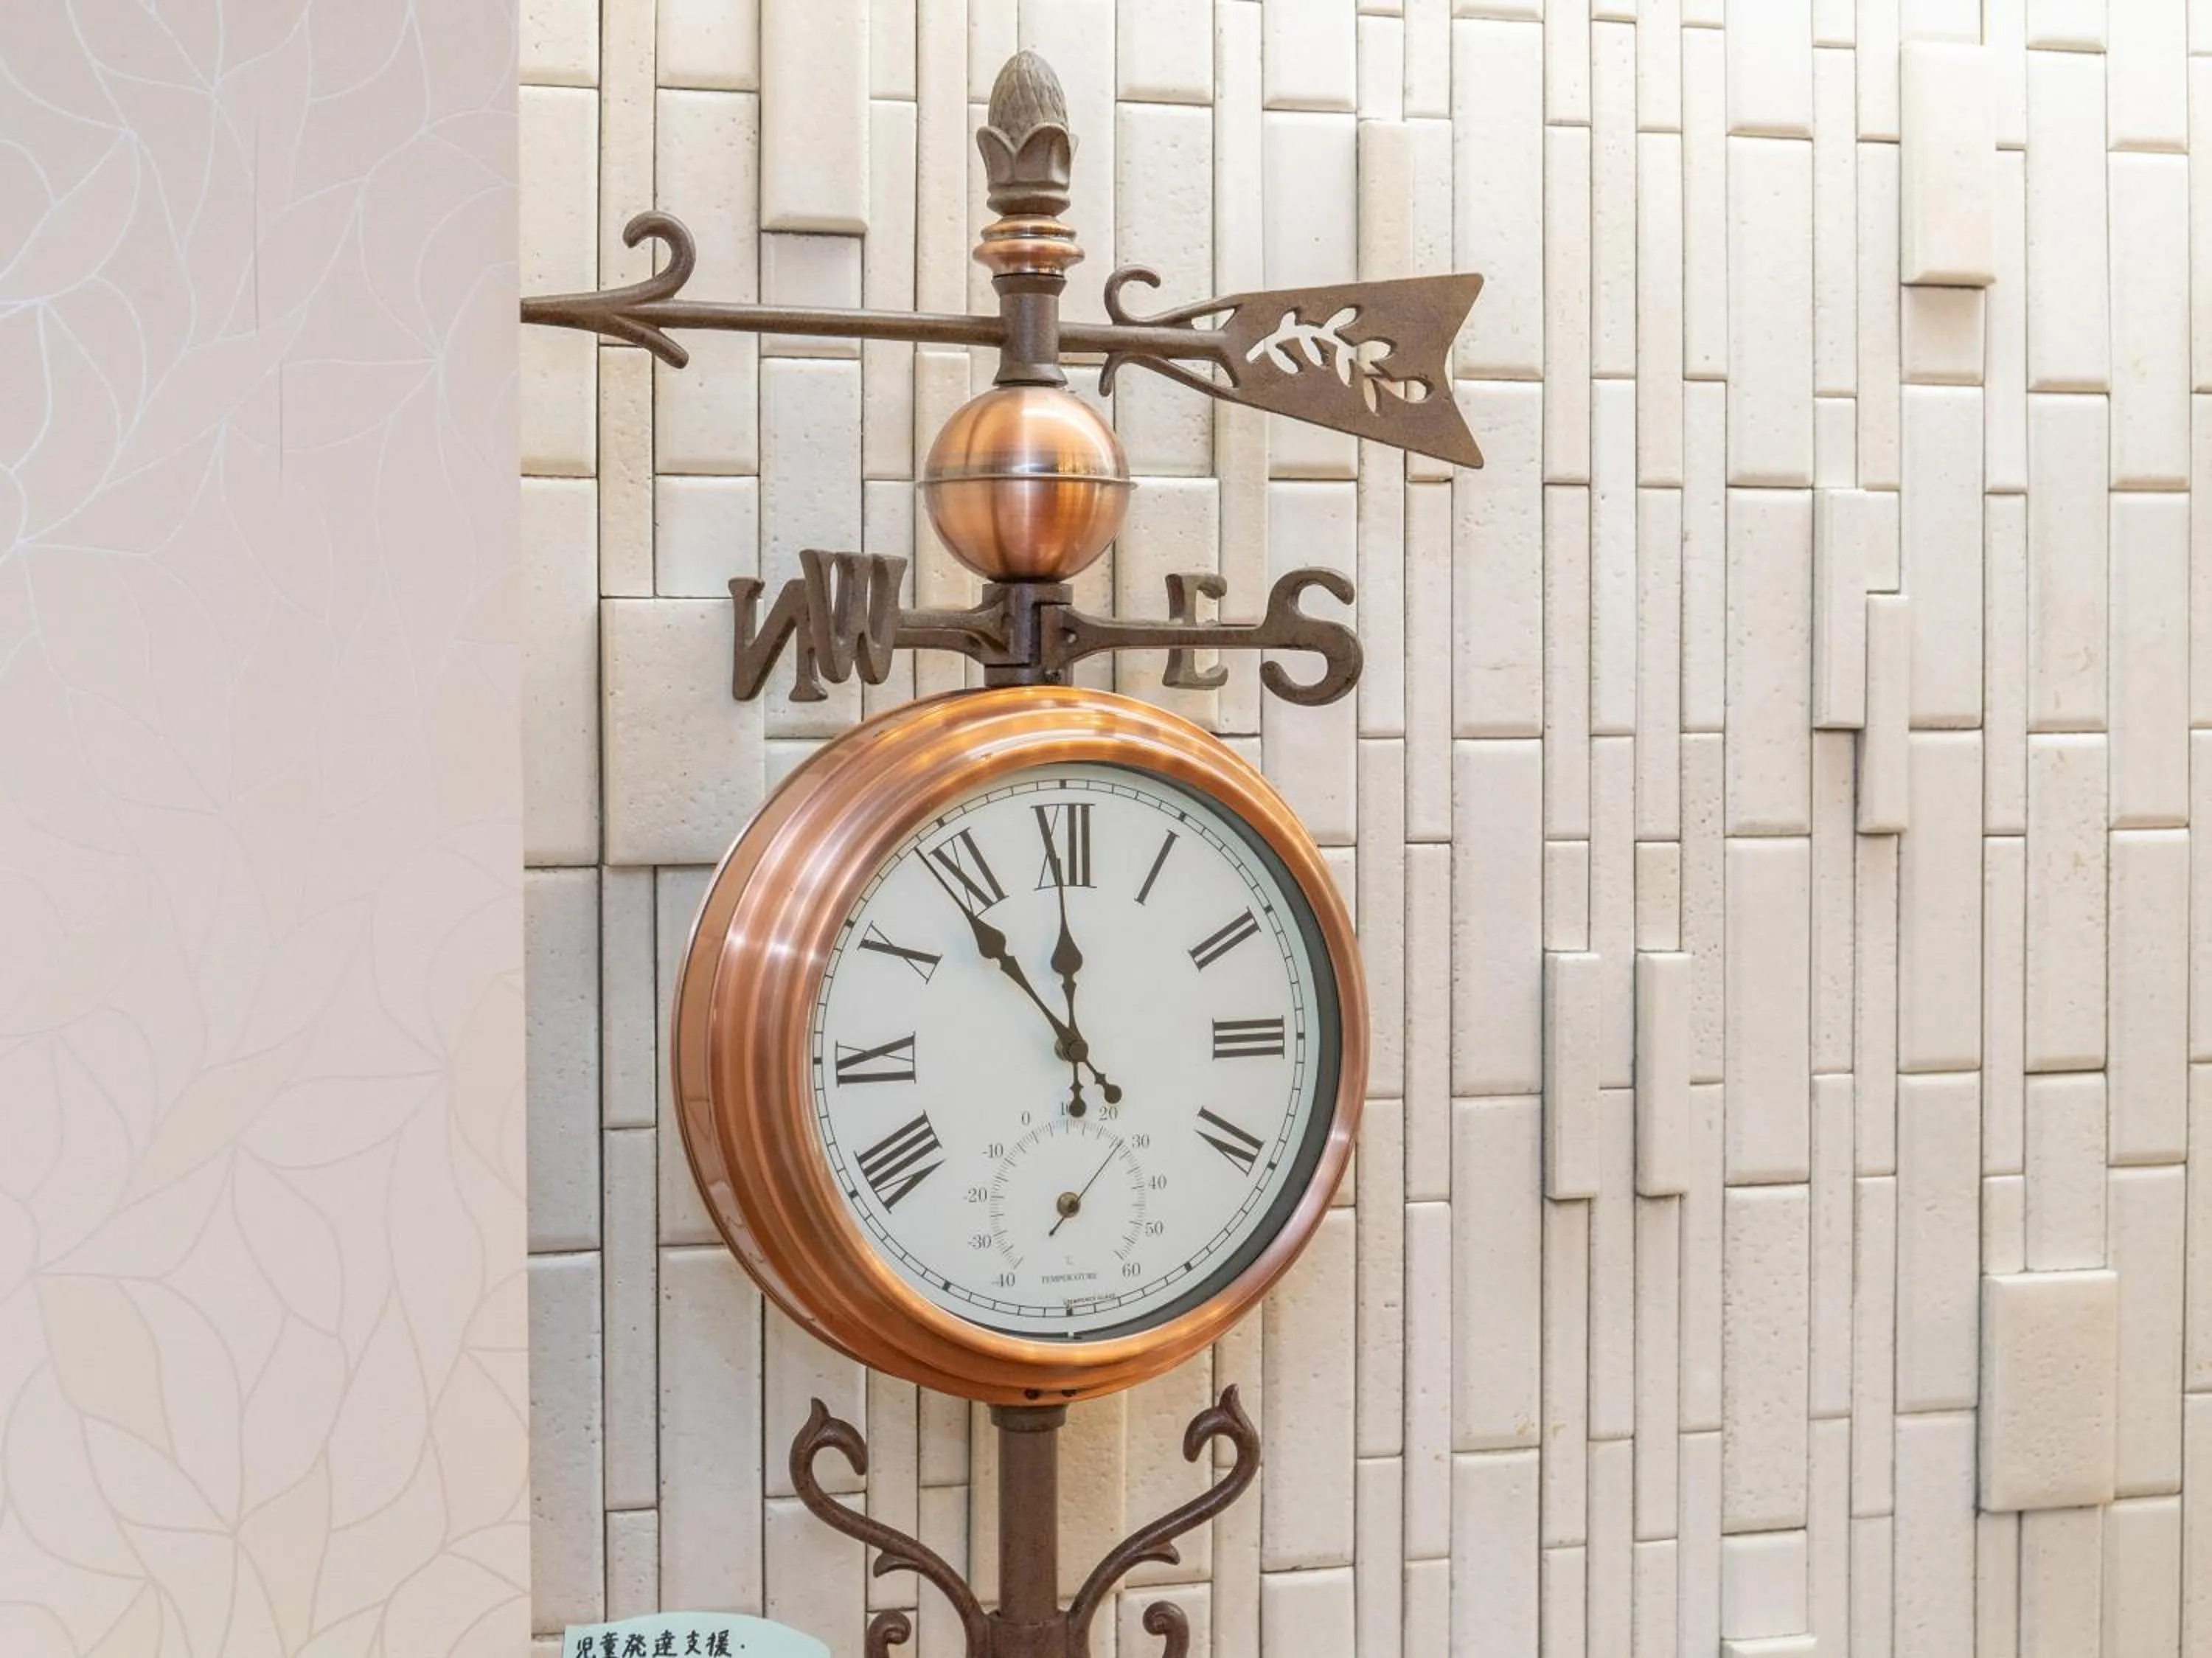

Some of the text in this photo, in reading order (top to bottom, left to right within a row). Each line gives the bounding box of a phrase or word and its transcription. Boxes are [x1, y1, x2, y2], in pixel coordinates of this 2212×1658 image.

[799, 549, 908, 684] W
[1165, 573, 1228, 690] E
[1259, 566, 1364, 707] S
[928, 826, 1009, 918] XI
[1030, 802, 1097, 891] XII
[857, 920, 944, 985] X
[1188, 905, 1262, 971] II
[835, 1030, 917, 1088] IX
[1211, 1014, 1285, 1059] III
[1021, 1111, 1031, 1125] 0
[1099, 1106, 1119, 1120] 20
[853, 1109, 947, 1214] VIII
[981, 1143, 1004, 1159] -10
[1131, 1134, 1150, 1148] 30
[1194, 1106, 1265, 1176] IV
[963, 1187, 988, 1204] -20
[1148, 1175, 1168, 1190] 40
[967, 1235, 992, 1249] -30
[1144, 1221, 1164, 1235] 50
[1121, 1262, 1141, 1277] 60
